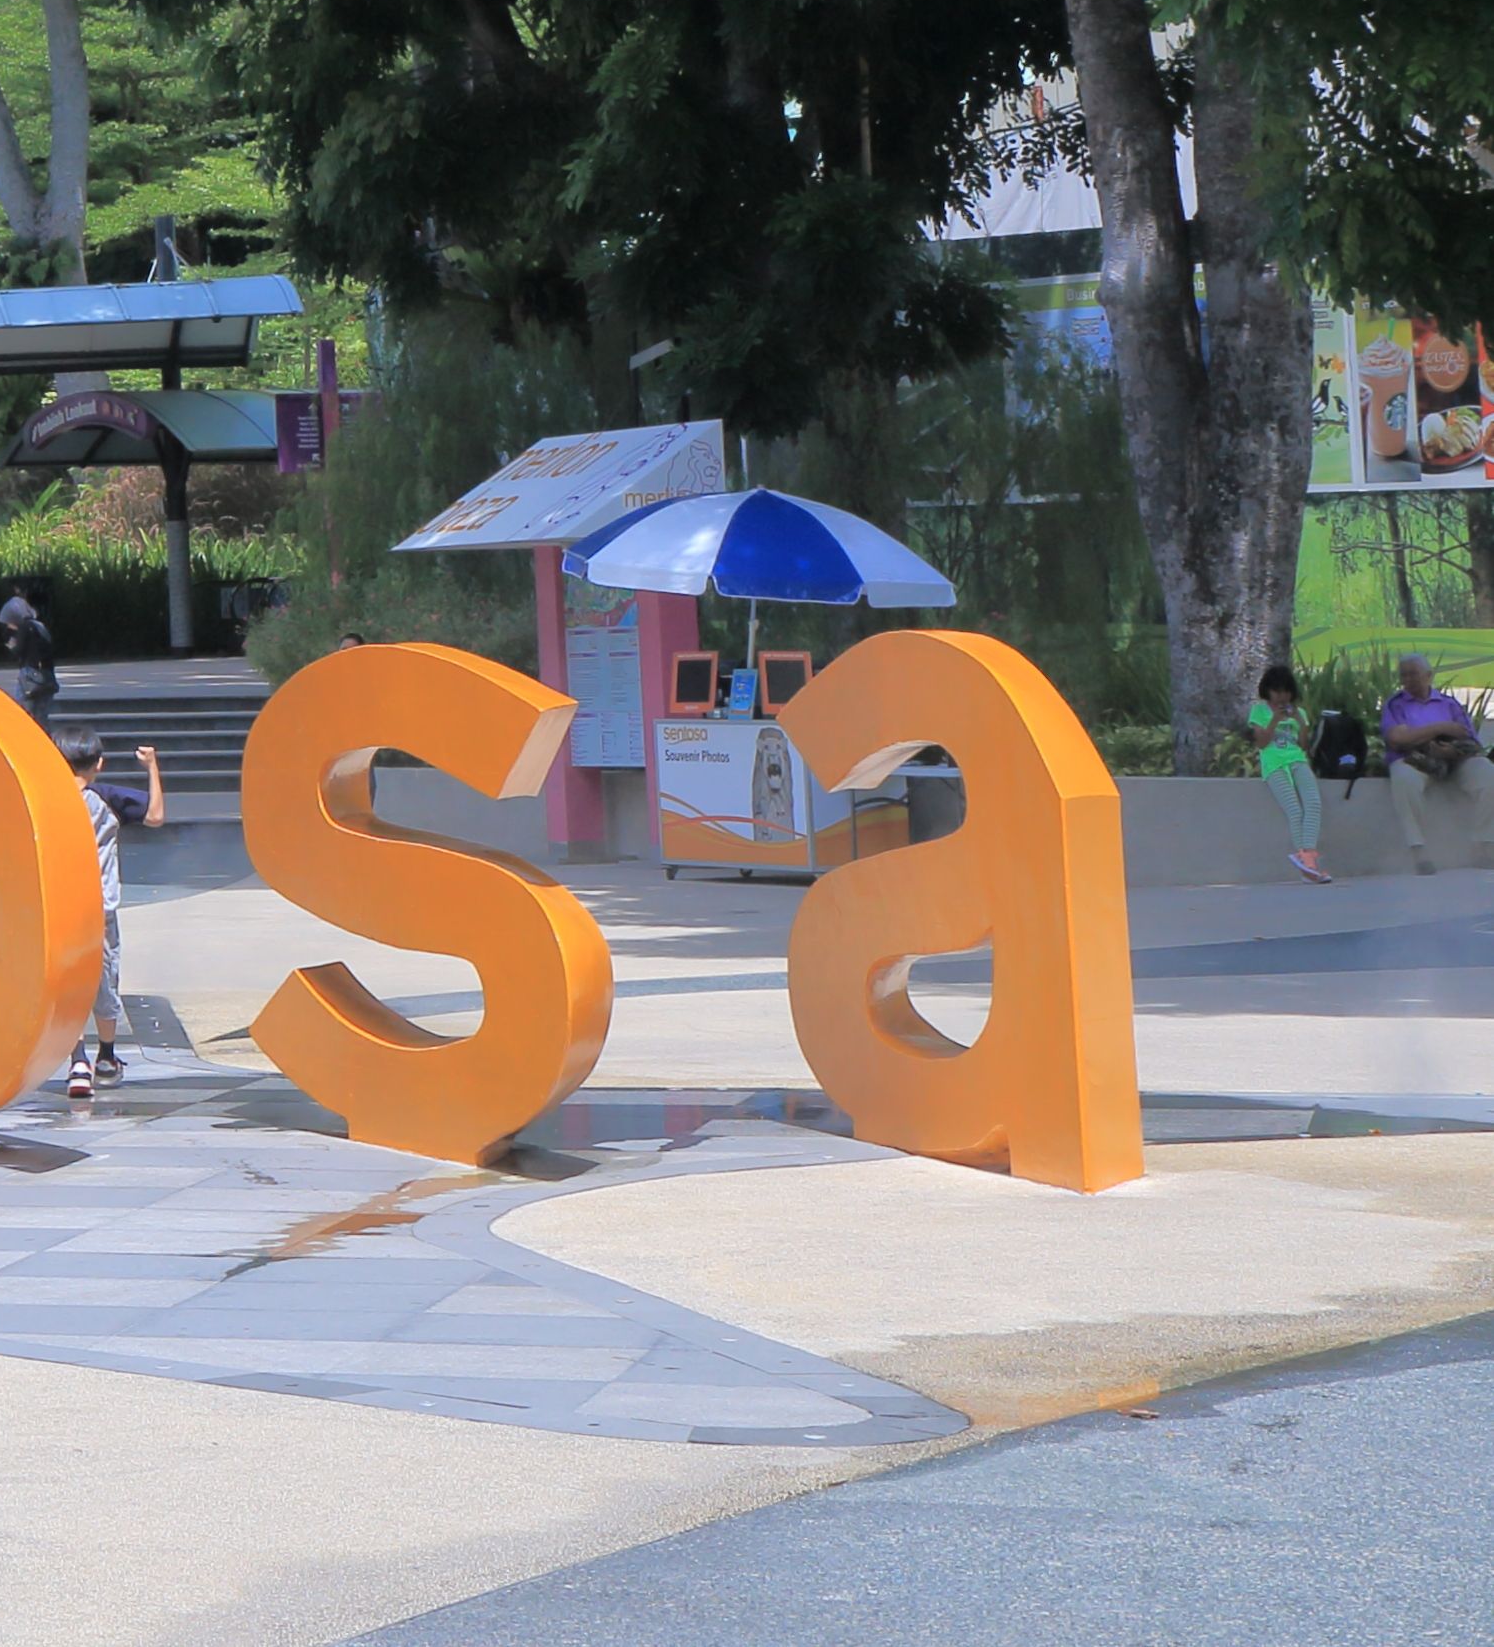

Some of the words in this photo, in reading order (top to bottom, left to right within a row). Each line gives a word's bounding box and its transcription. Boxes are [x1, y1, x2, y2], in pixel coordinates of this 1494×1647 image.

[663, 726, 708, 741] sentosa
[665, 749, 700, 762] Souvenir
[701, 750, 730, 763] Photos
